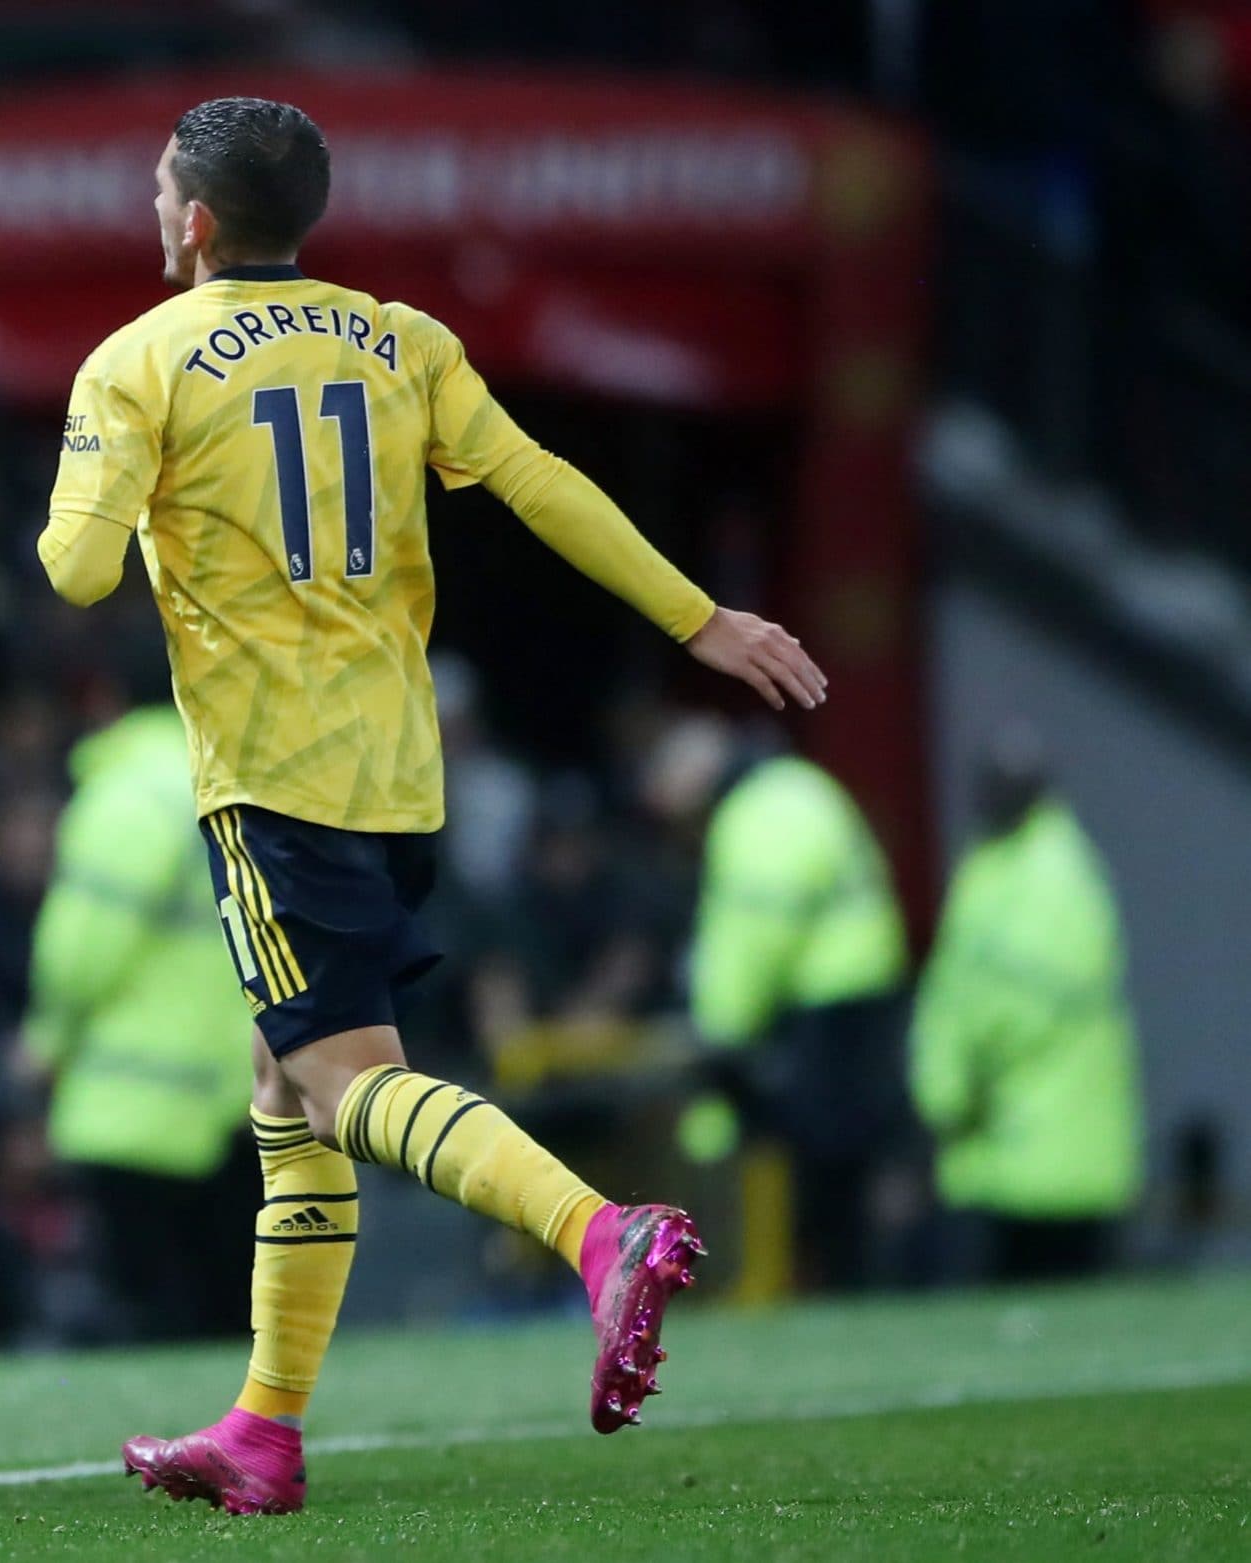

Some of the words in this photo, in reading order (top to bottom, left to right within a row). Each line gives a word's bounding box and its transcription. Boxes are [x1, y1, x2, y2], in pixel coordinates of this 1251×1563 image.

[184, 303, 397, 381] TORREIRA
[252, 379, 375, 584] 11
[271, 1222, 340, 1232] adidas
